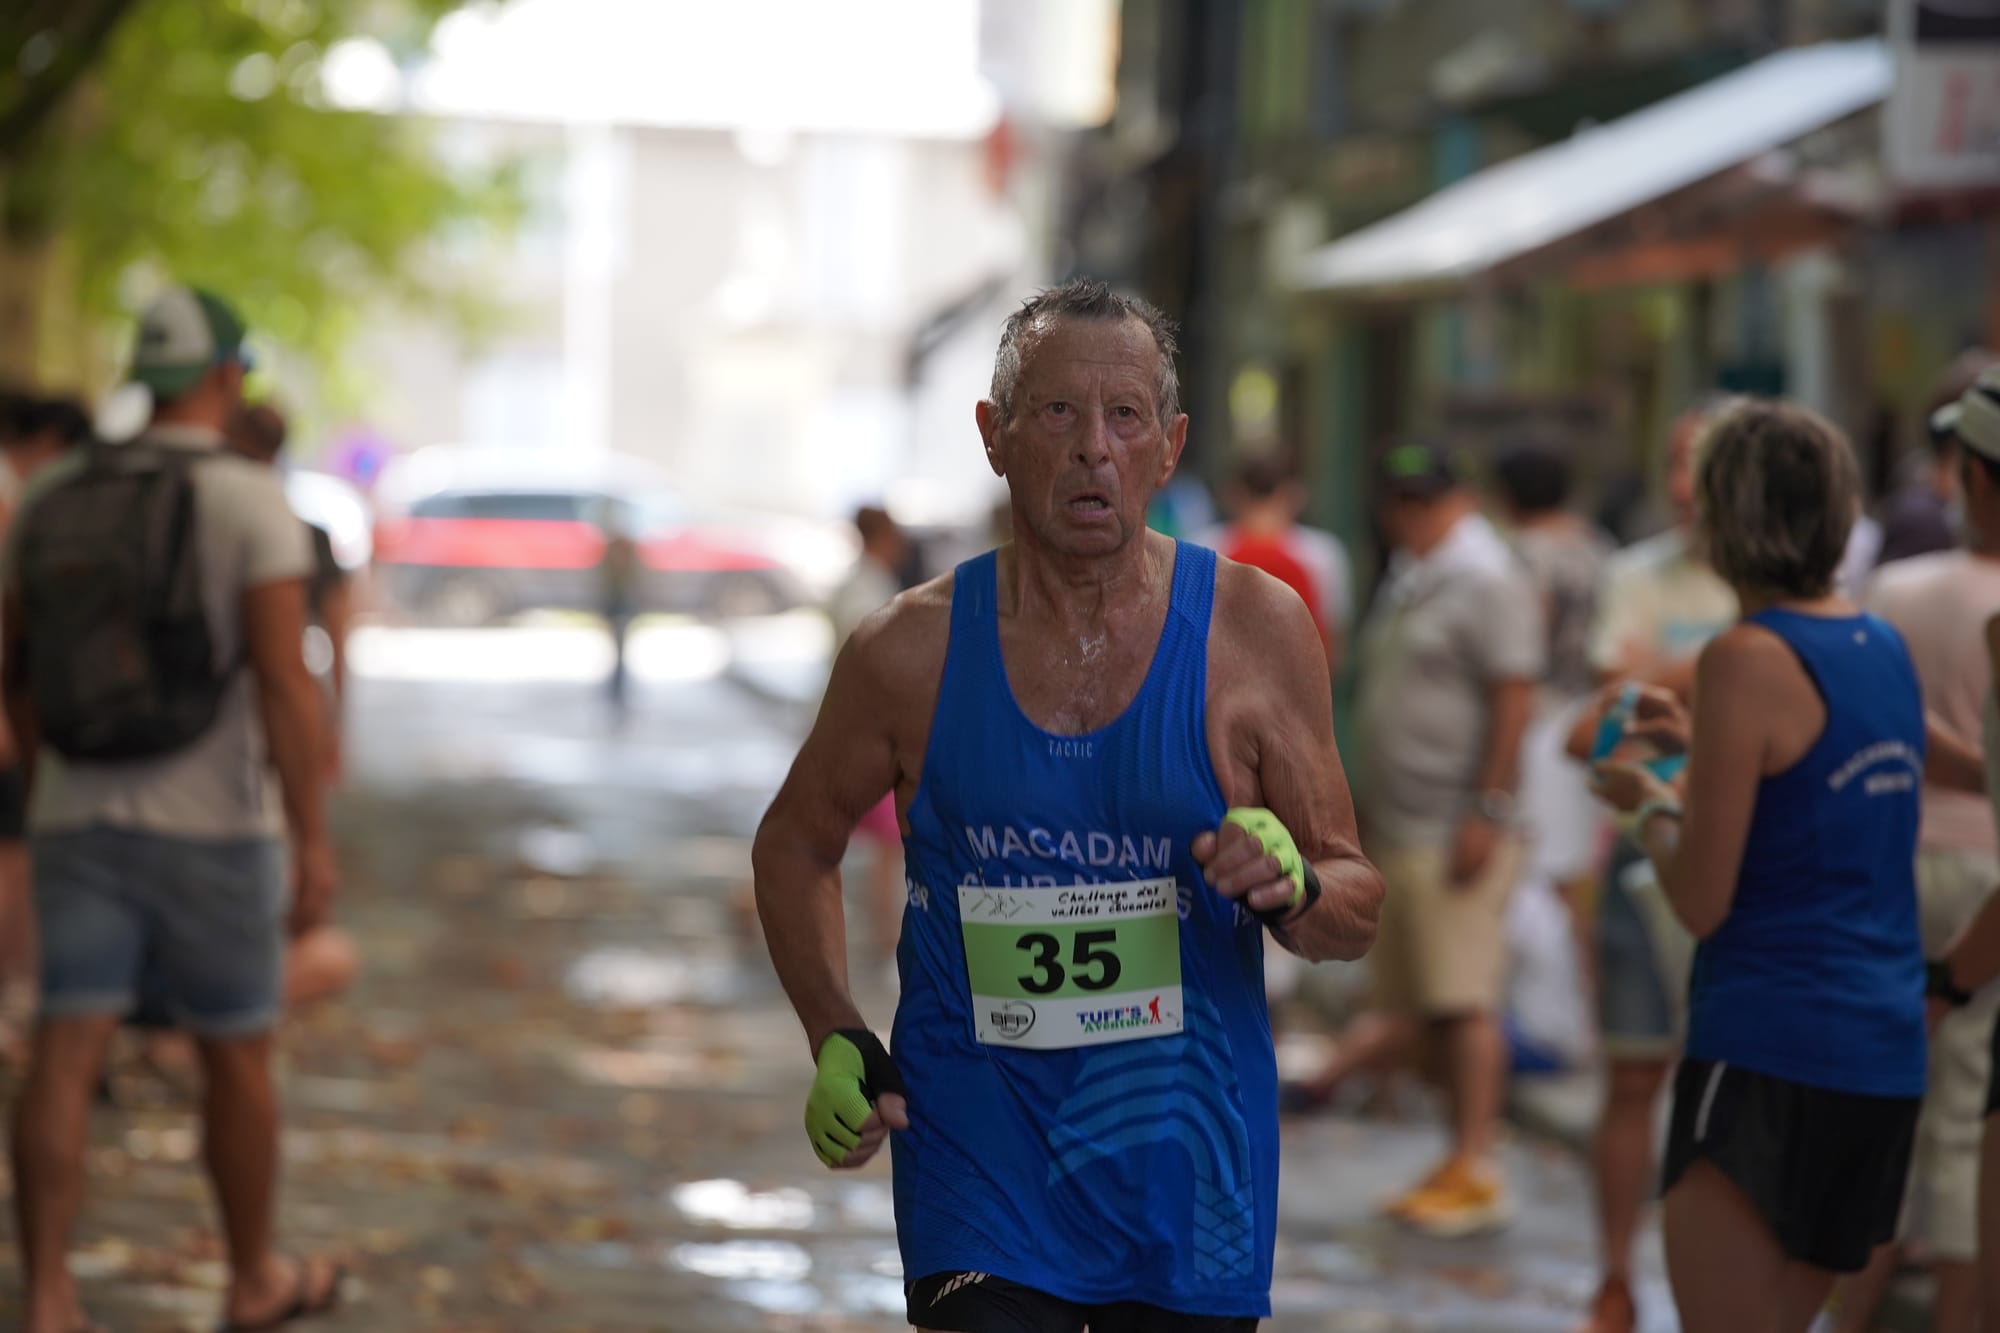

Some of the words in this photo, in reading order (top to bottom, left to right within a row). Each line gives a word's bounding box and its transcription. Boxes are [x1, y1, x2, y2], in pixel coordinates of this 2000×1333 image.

[1048, 739, 1093, 758] TACTIC
[965, 826, 1172, 870] MACADAM
[1058, 889, 1128, 905] Challenge
[1137, 885, 1160, 898] des
[1016, 928, 1121, 995] 35
[1076, 1005, 1142, 1025] TUFF'S
[1084, 1017, 1149, 1033] Aventure
